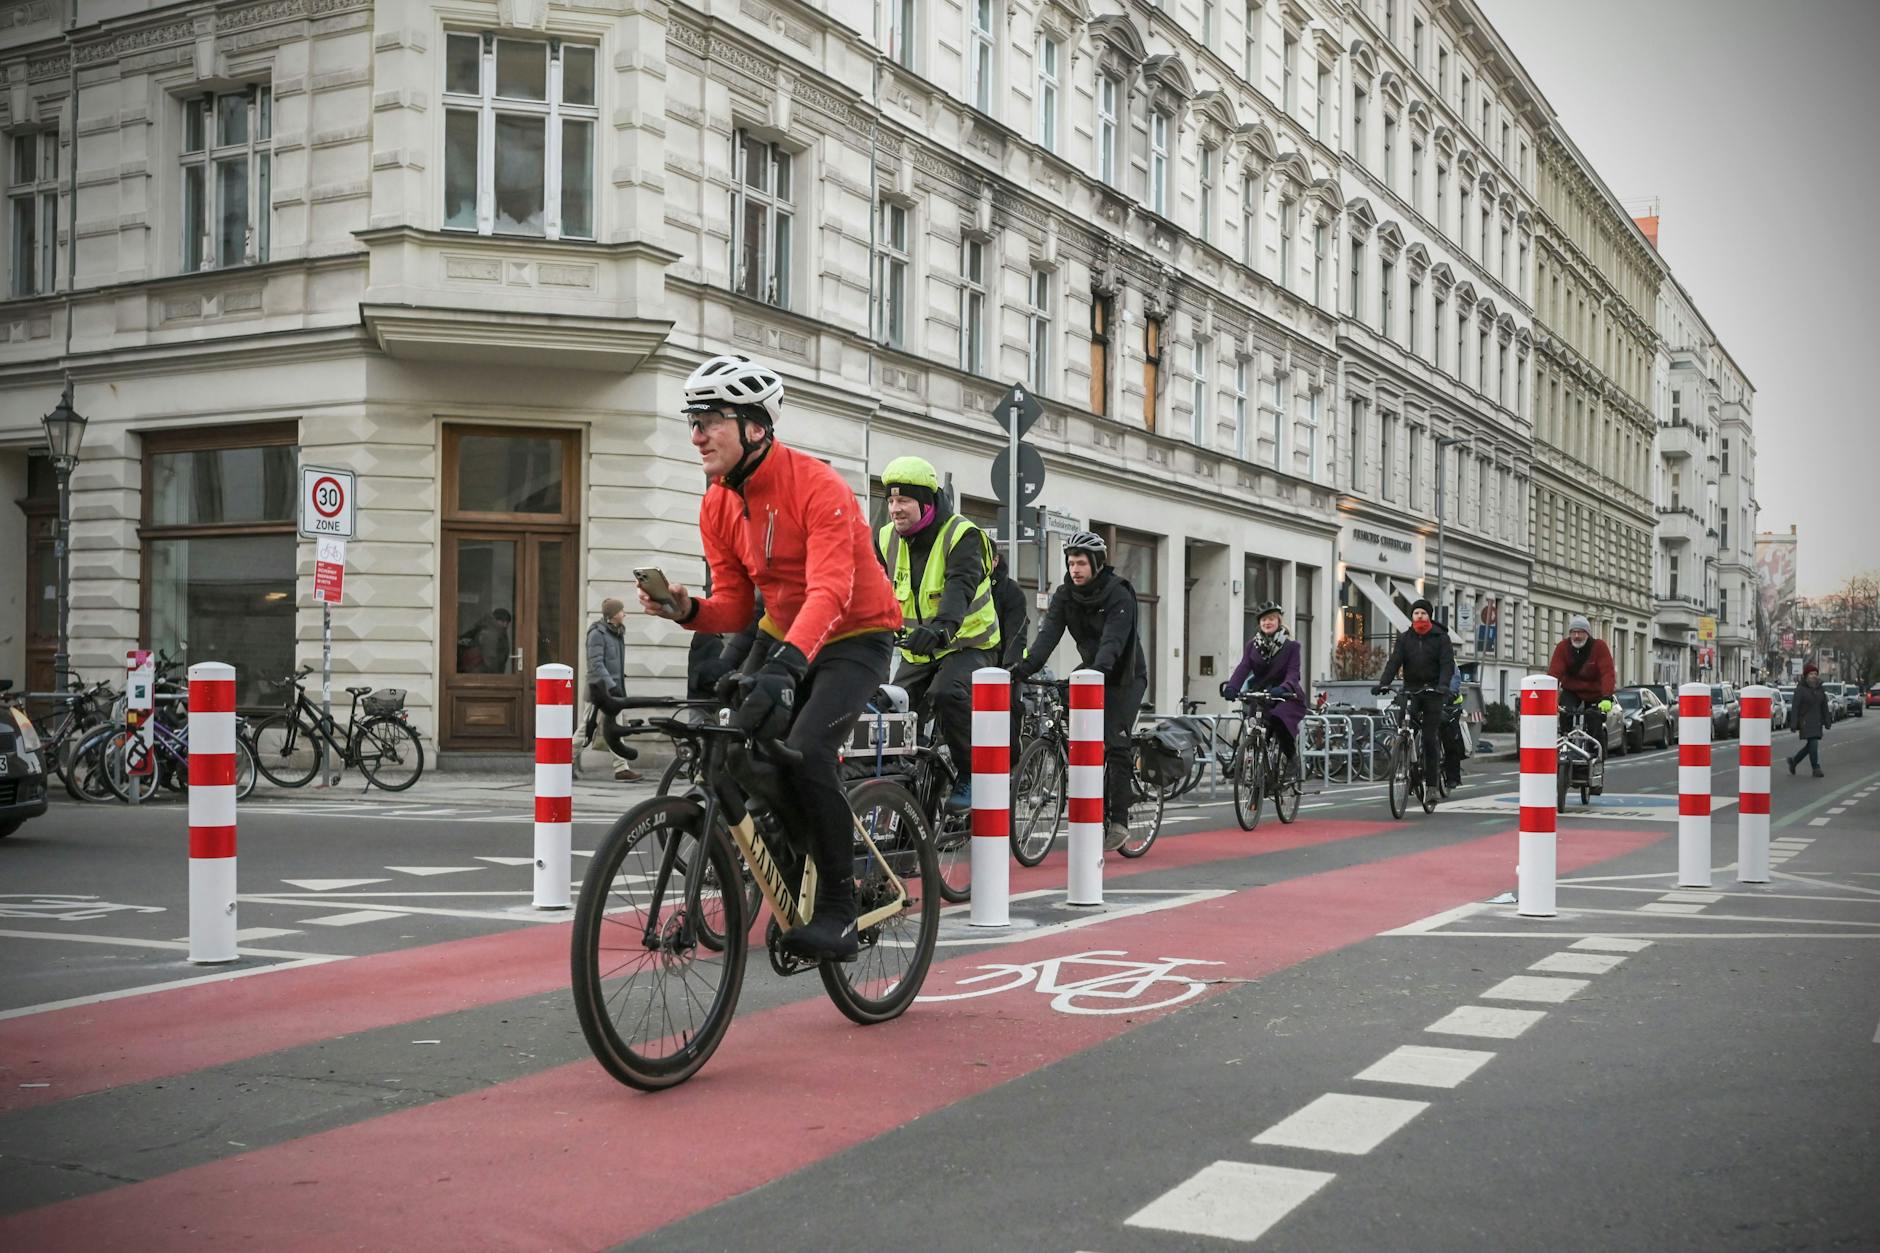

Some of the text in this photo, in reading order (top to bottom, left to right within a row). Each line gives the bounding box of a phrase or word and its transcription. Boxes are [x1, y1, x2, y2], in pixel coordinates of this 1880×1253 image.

[319, 487, 338, 507] 30
[316, 519, 340, 531] ZONE
[903, 801, 921, 825] SWISS
[626, 811, 666, 848] DT SWISS
[750, 830, 797, 927] CANYON
